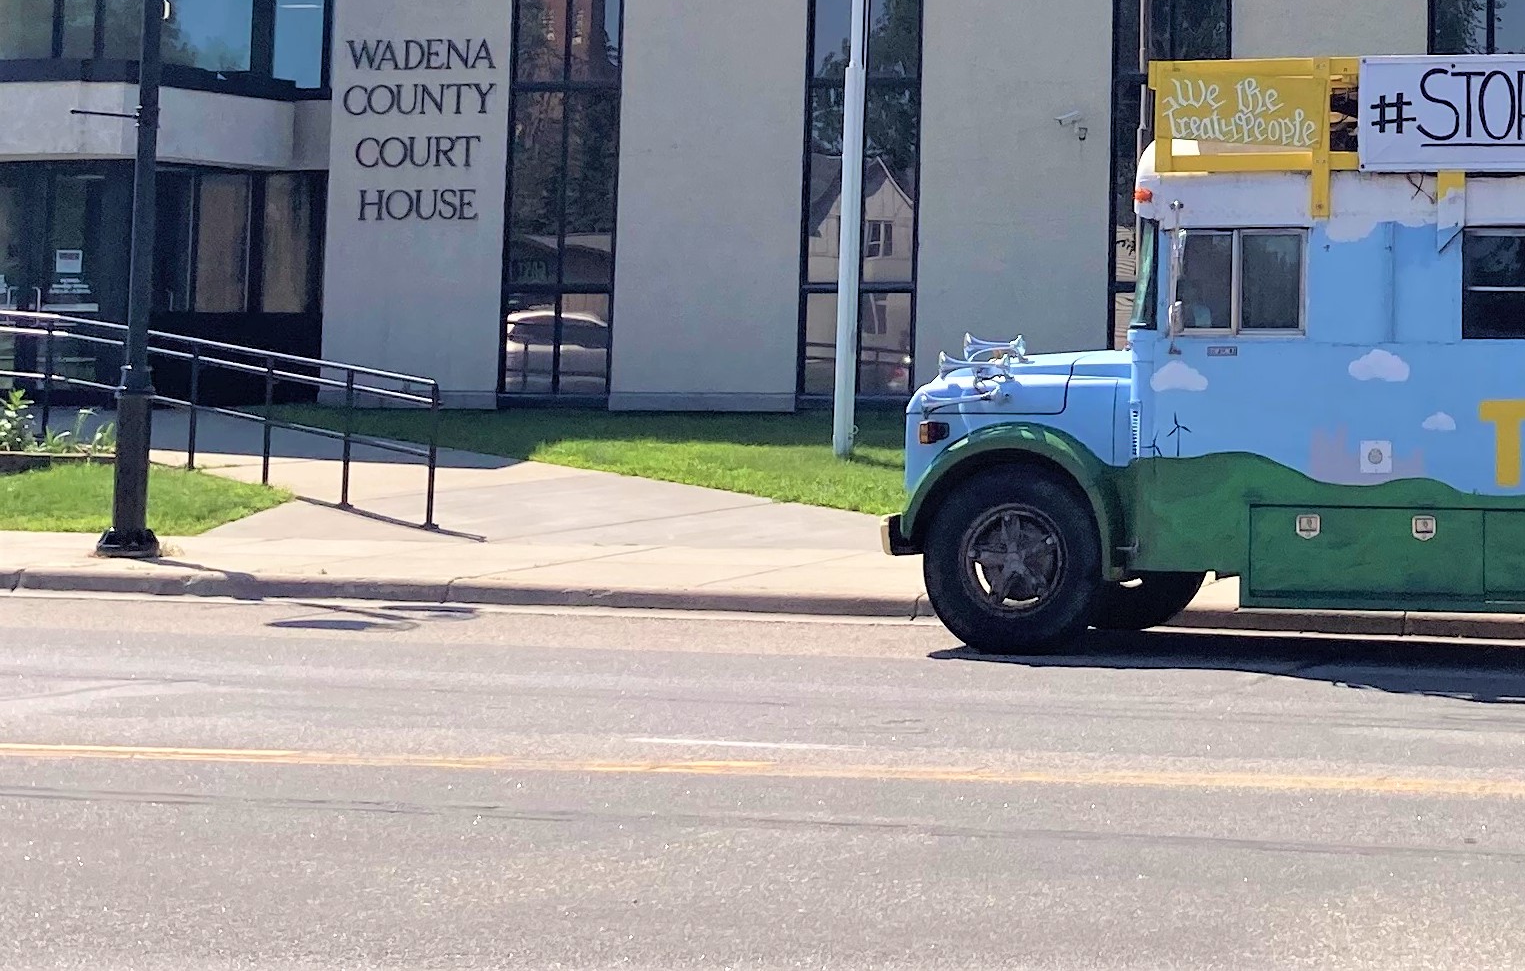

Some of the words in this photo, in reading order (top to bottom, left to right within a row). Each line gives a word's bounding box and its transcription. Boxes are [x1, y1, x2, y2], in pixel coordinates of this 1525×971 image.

[346, 38, 496, 71] WADENA
[343, 83, 496, 116] COUNTY
[1168, 78, 1226, 109] We
[1234, 77, 1284, 115] the
[355, 135, 481, 168] COURT
[357, 189, 479, 221] HOUSE
